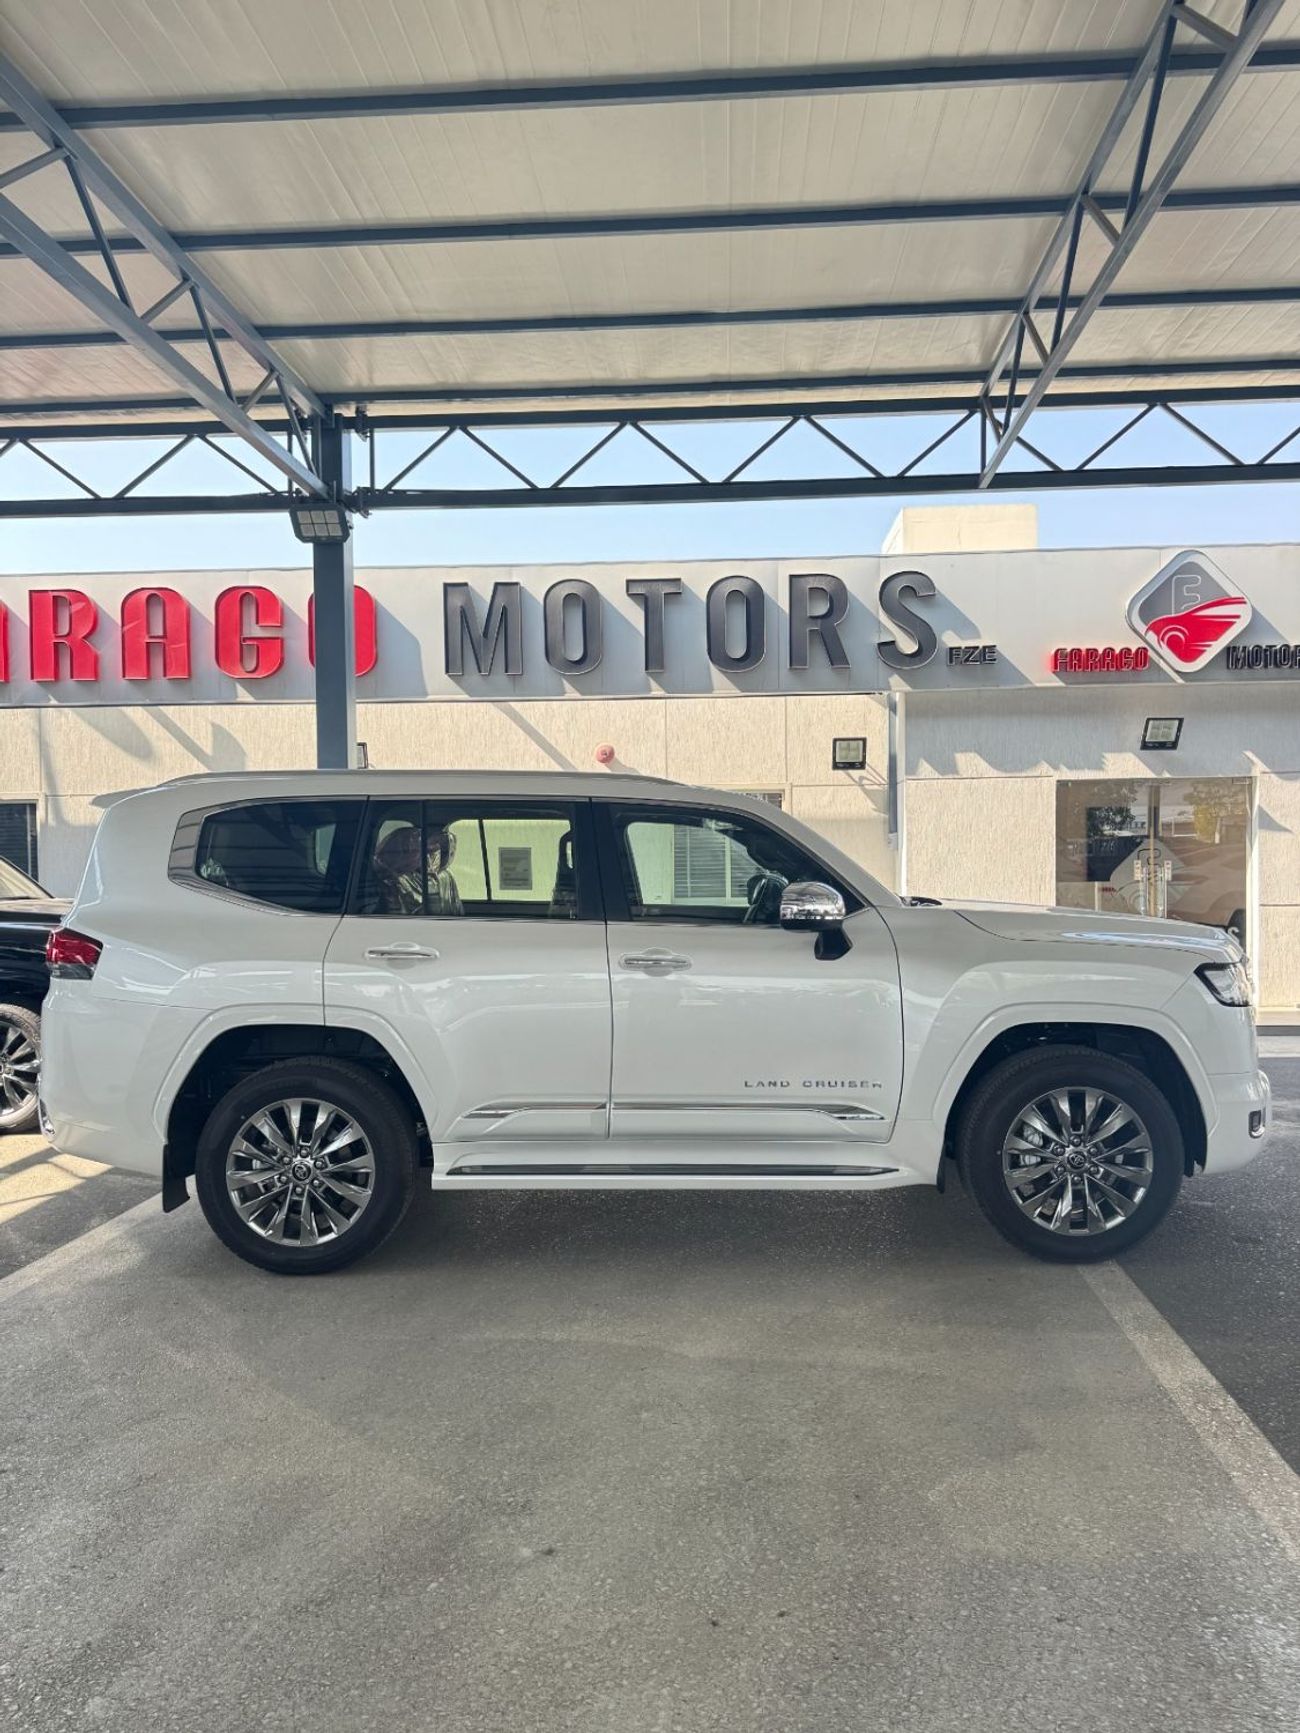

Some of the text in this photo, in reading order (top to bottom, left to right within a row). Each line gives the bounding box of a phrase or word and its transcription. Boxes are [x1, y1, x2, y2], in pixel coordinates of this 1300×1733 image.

[0, 570, 997, 683] RAG MOTORS FZE
[1052, 646, 1150, 672] FARAGO
[744, 1080, 883, 1089] LAND CRUISER
